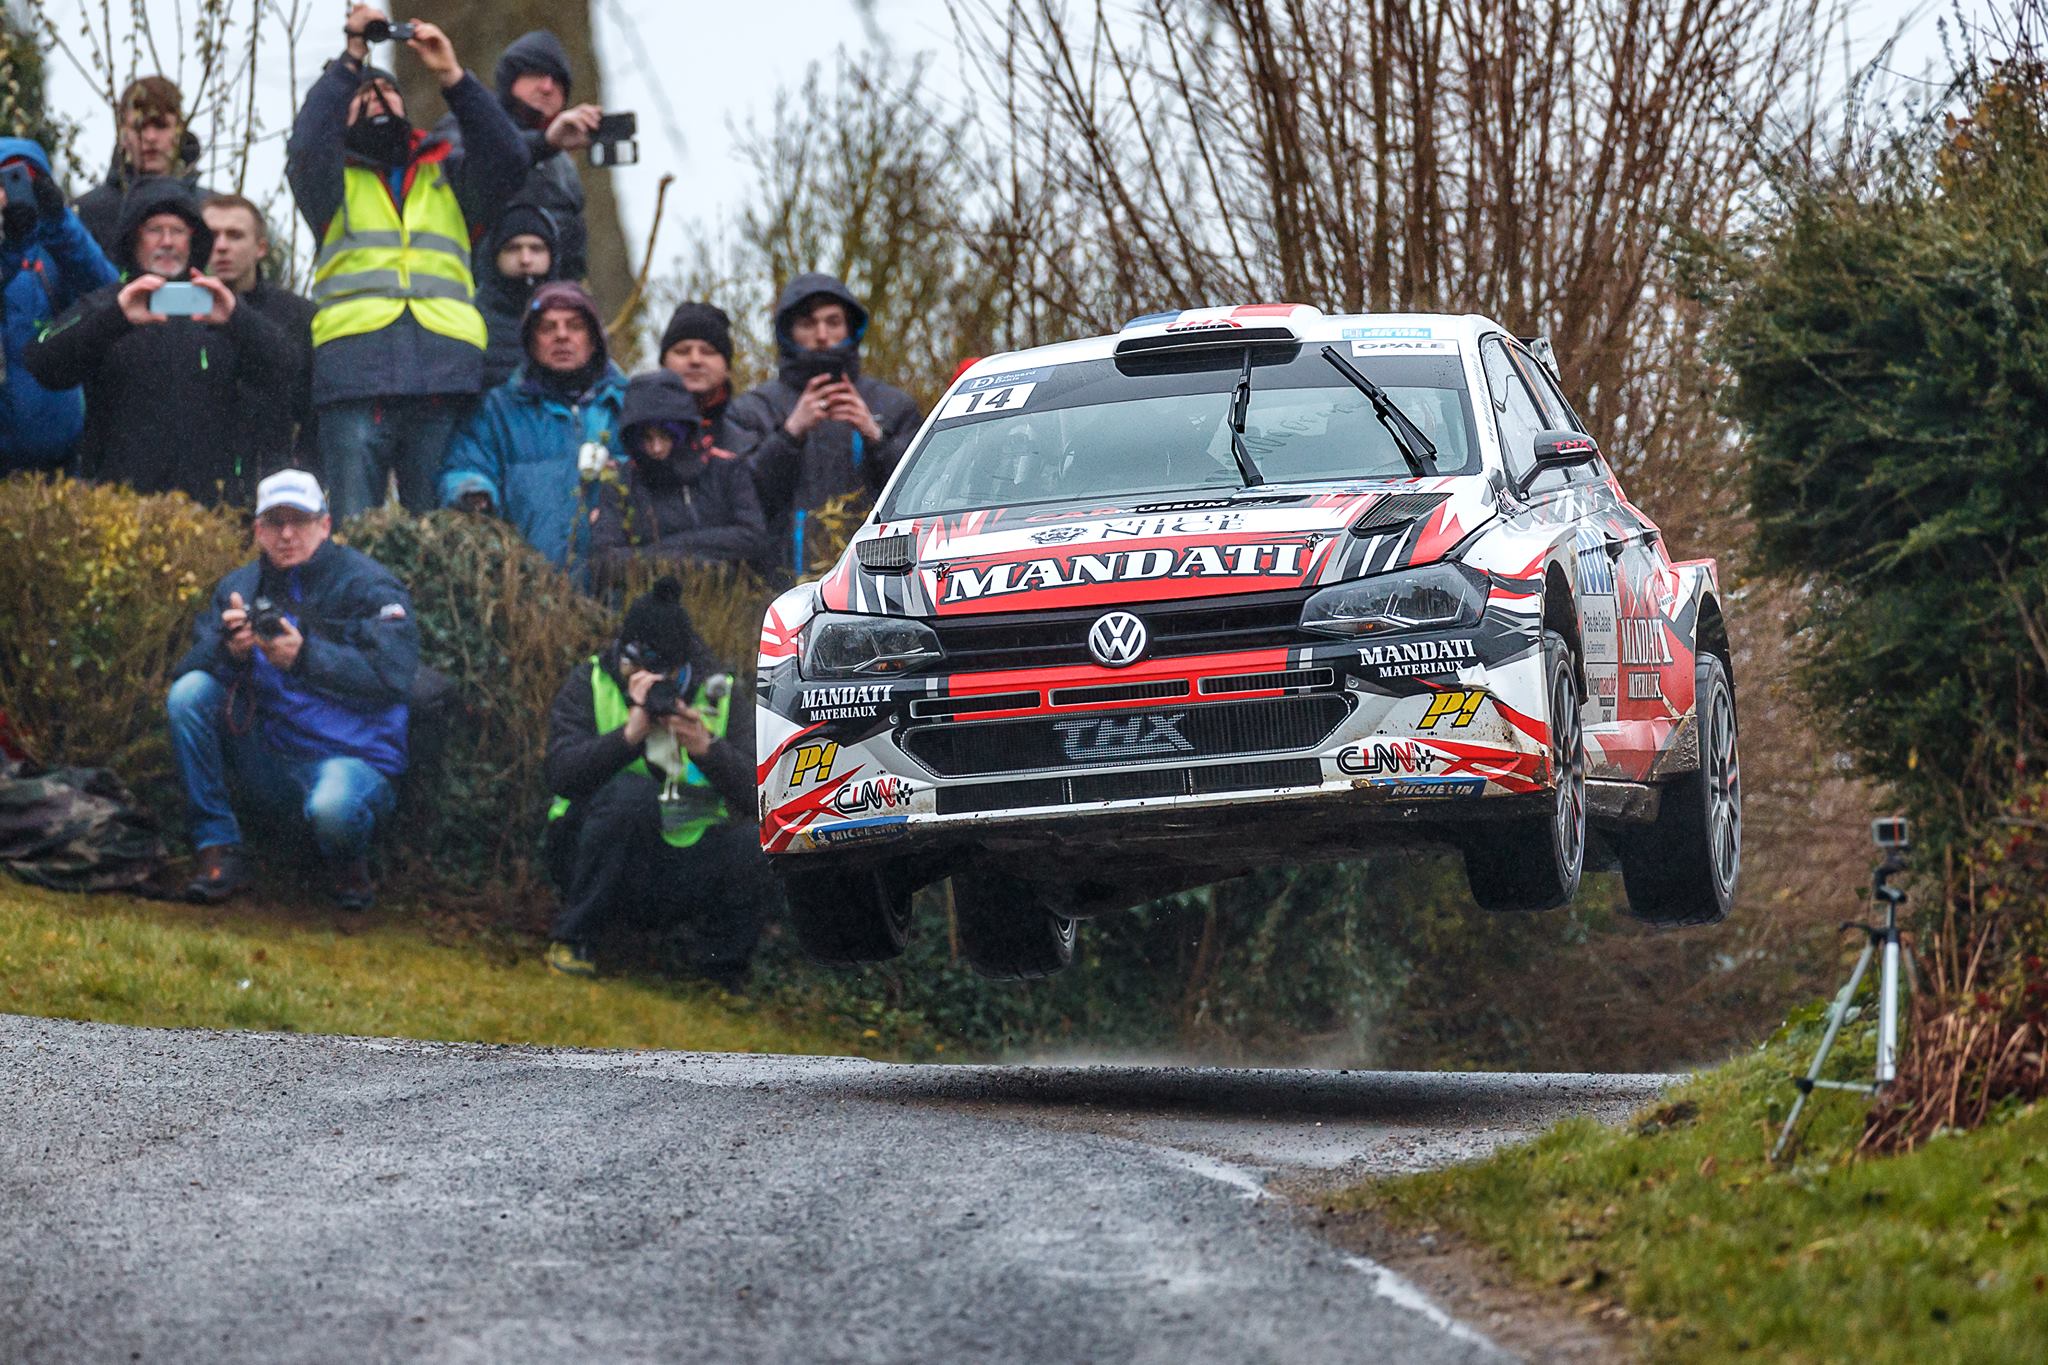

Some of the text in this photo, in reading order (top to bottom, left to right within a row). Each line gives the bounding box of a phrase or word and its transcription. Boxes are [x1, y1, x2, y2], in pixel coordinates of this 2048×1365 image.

[965, 387, 1015, 413] 14
[1100, 518, 1245, 539] NICE
[942, 544, 1304, 603] MANDATI
[1357, 638, 1477, 666] MANDATI
[1379, 660, 1466, 678] MATERIAUX
[800, 684, 894, 709] MANDATI
[810, 705, 877, 722] MATERIAUX
[1053, 712, 1196, 761] THX
